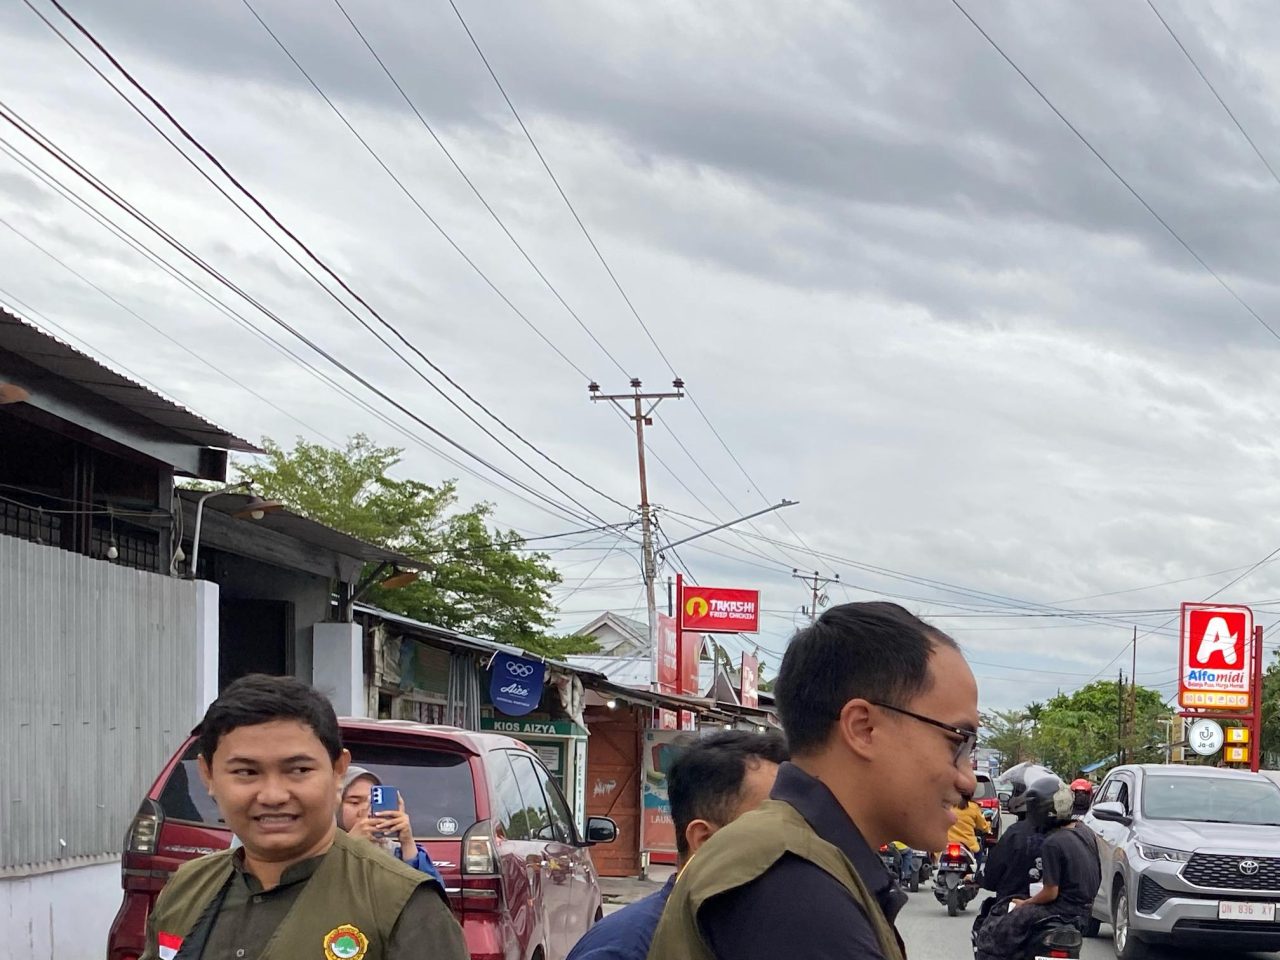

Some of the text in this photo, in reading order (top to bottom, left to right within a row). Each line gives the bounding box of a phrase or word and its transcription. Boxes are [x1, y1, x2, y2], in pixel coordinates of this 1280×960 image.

[710, 600, 754, 612] TAKASHI
[1188, 670, 1245, 683] Alfamidi
[500, 683, 528, 696] Aice
[494, 721, 556, 734] KIOS AIZYA
